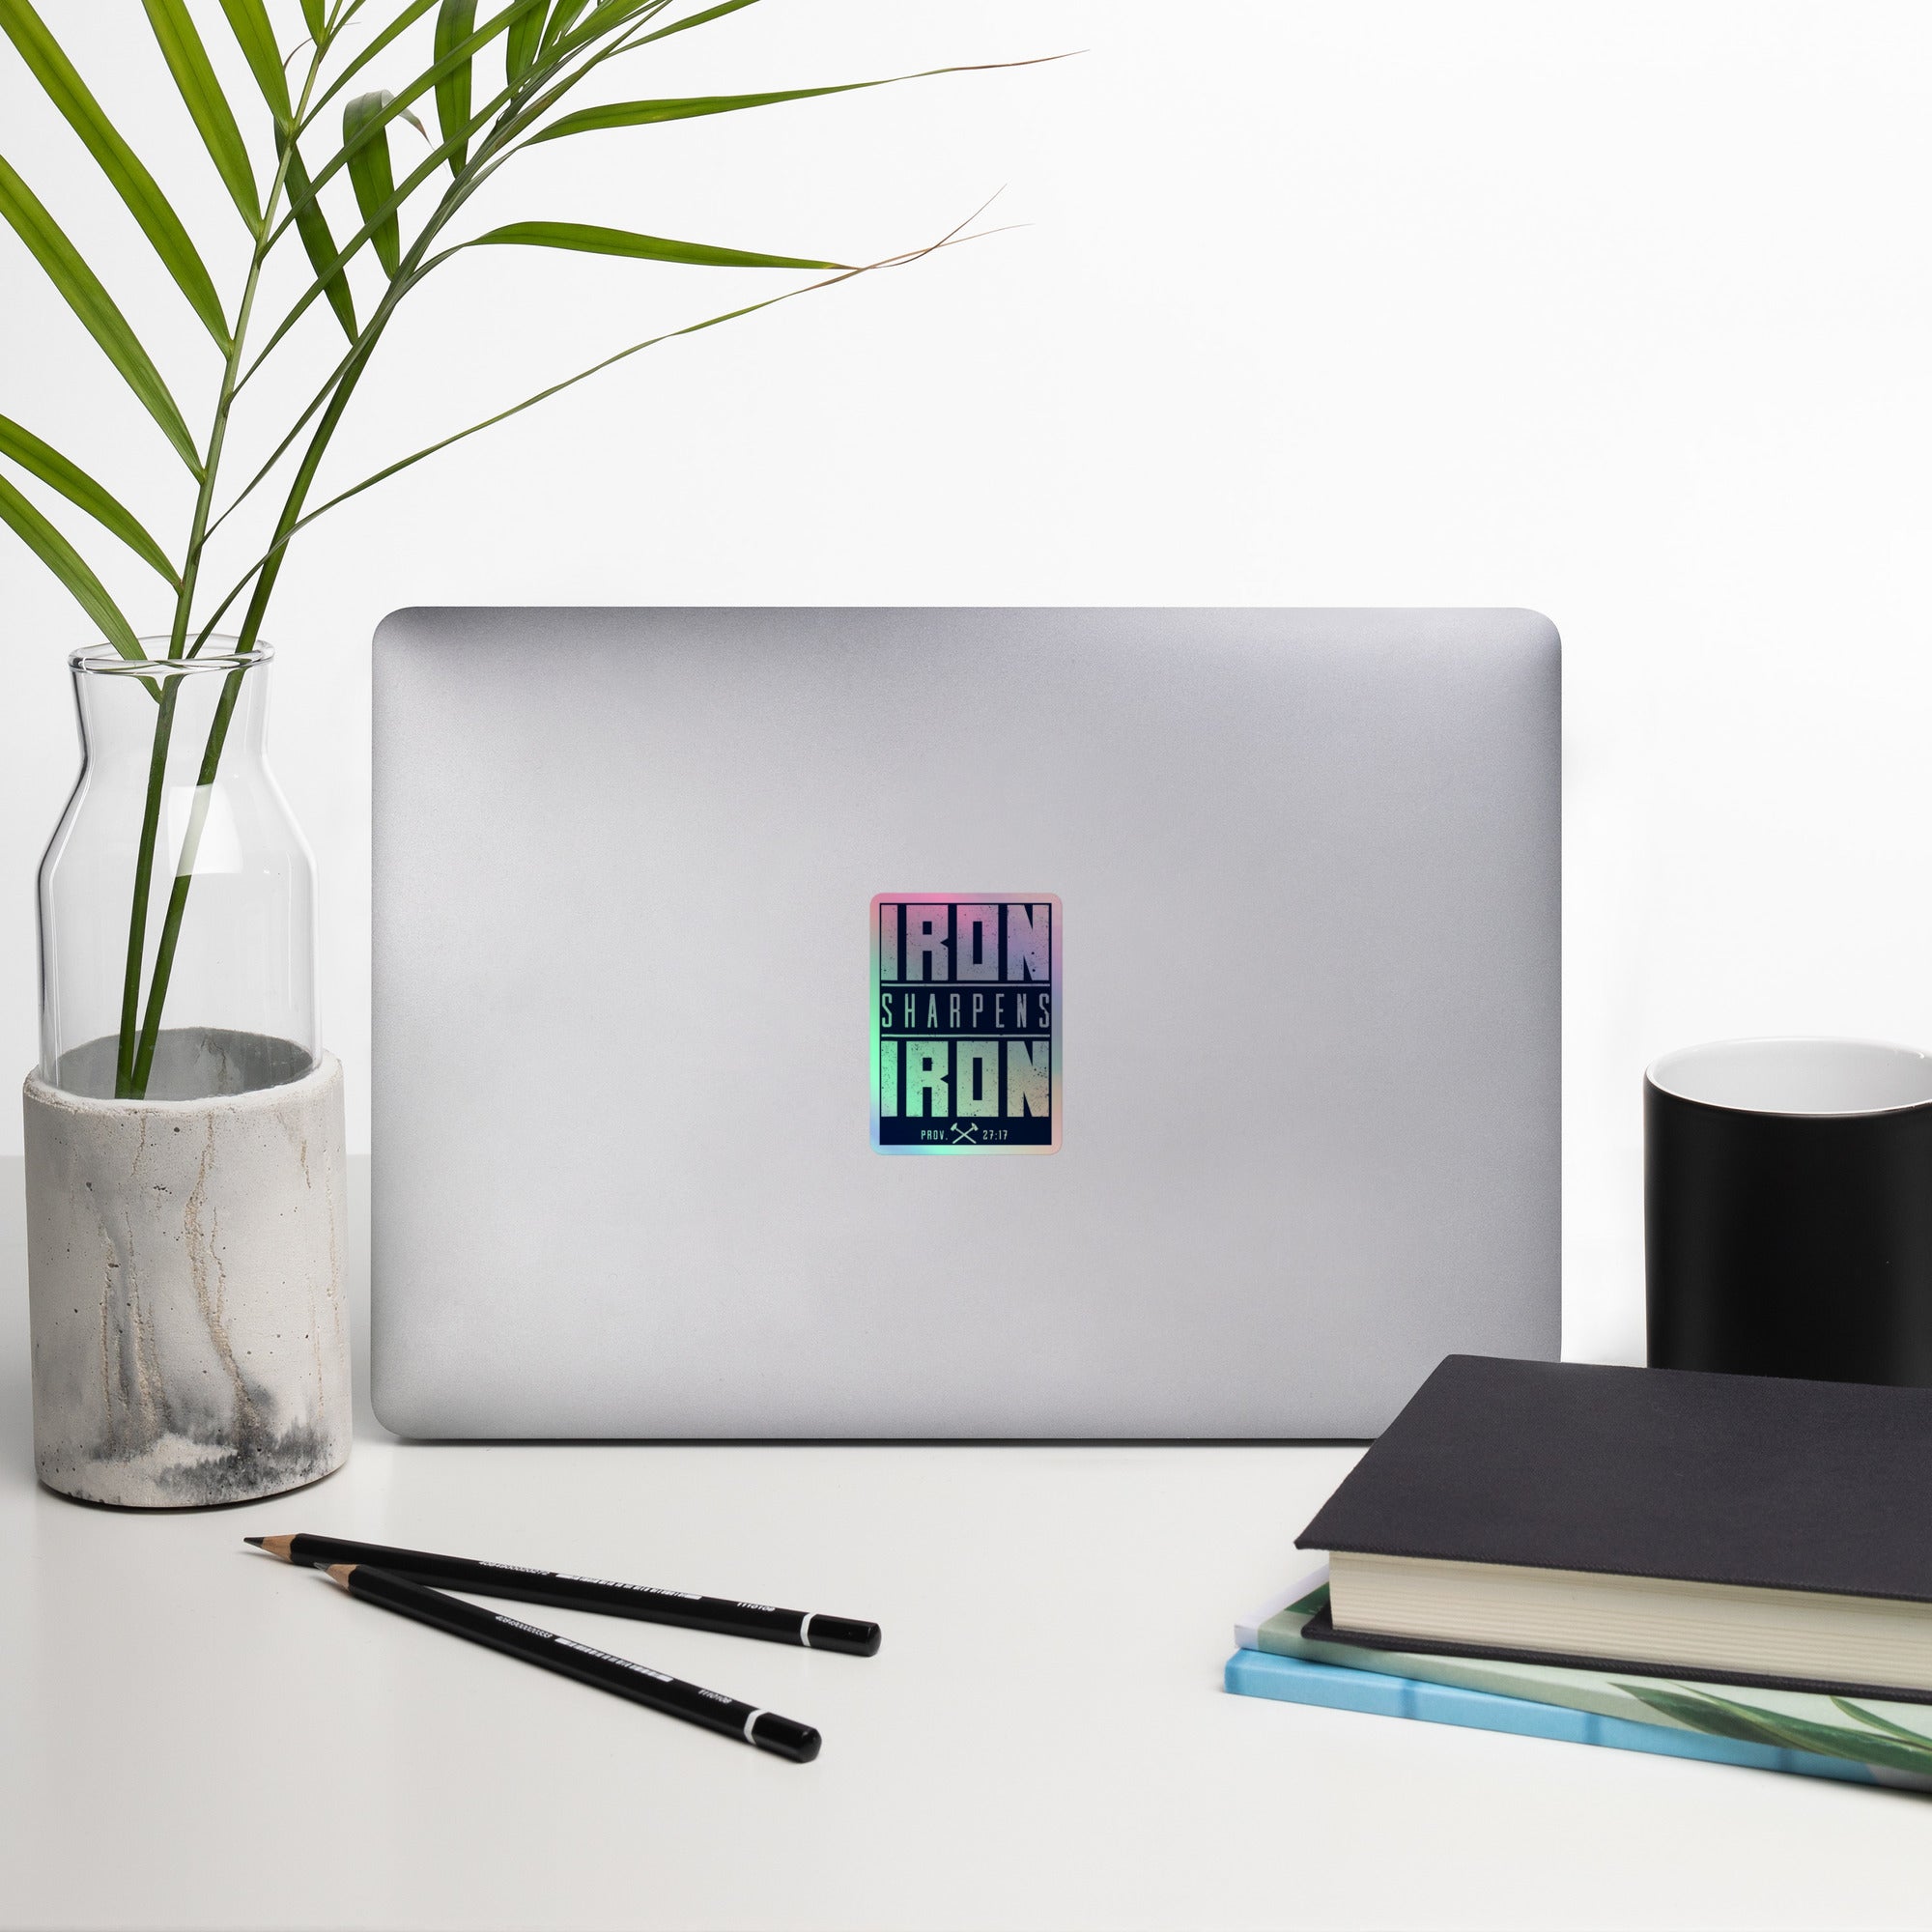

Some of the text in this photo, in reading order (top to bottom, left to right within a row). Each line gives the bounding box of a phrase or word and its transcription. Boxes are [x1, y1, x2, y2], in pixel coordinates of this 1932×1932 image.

[880, 904, 1050, 980] IRON
[881, 993, 1050, 1029] SHARPENS
[880, 1040, 1050, 1117] IRON
[921, 1129, 1009, 1141] PROV. 27:17
